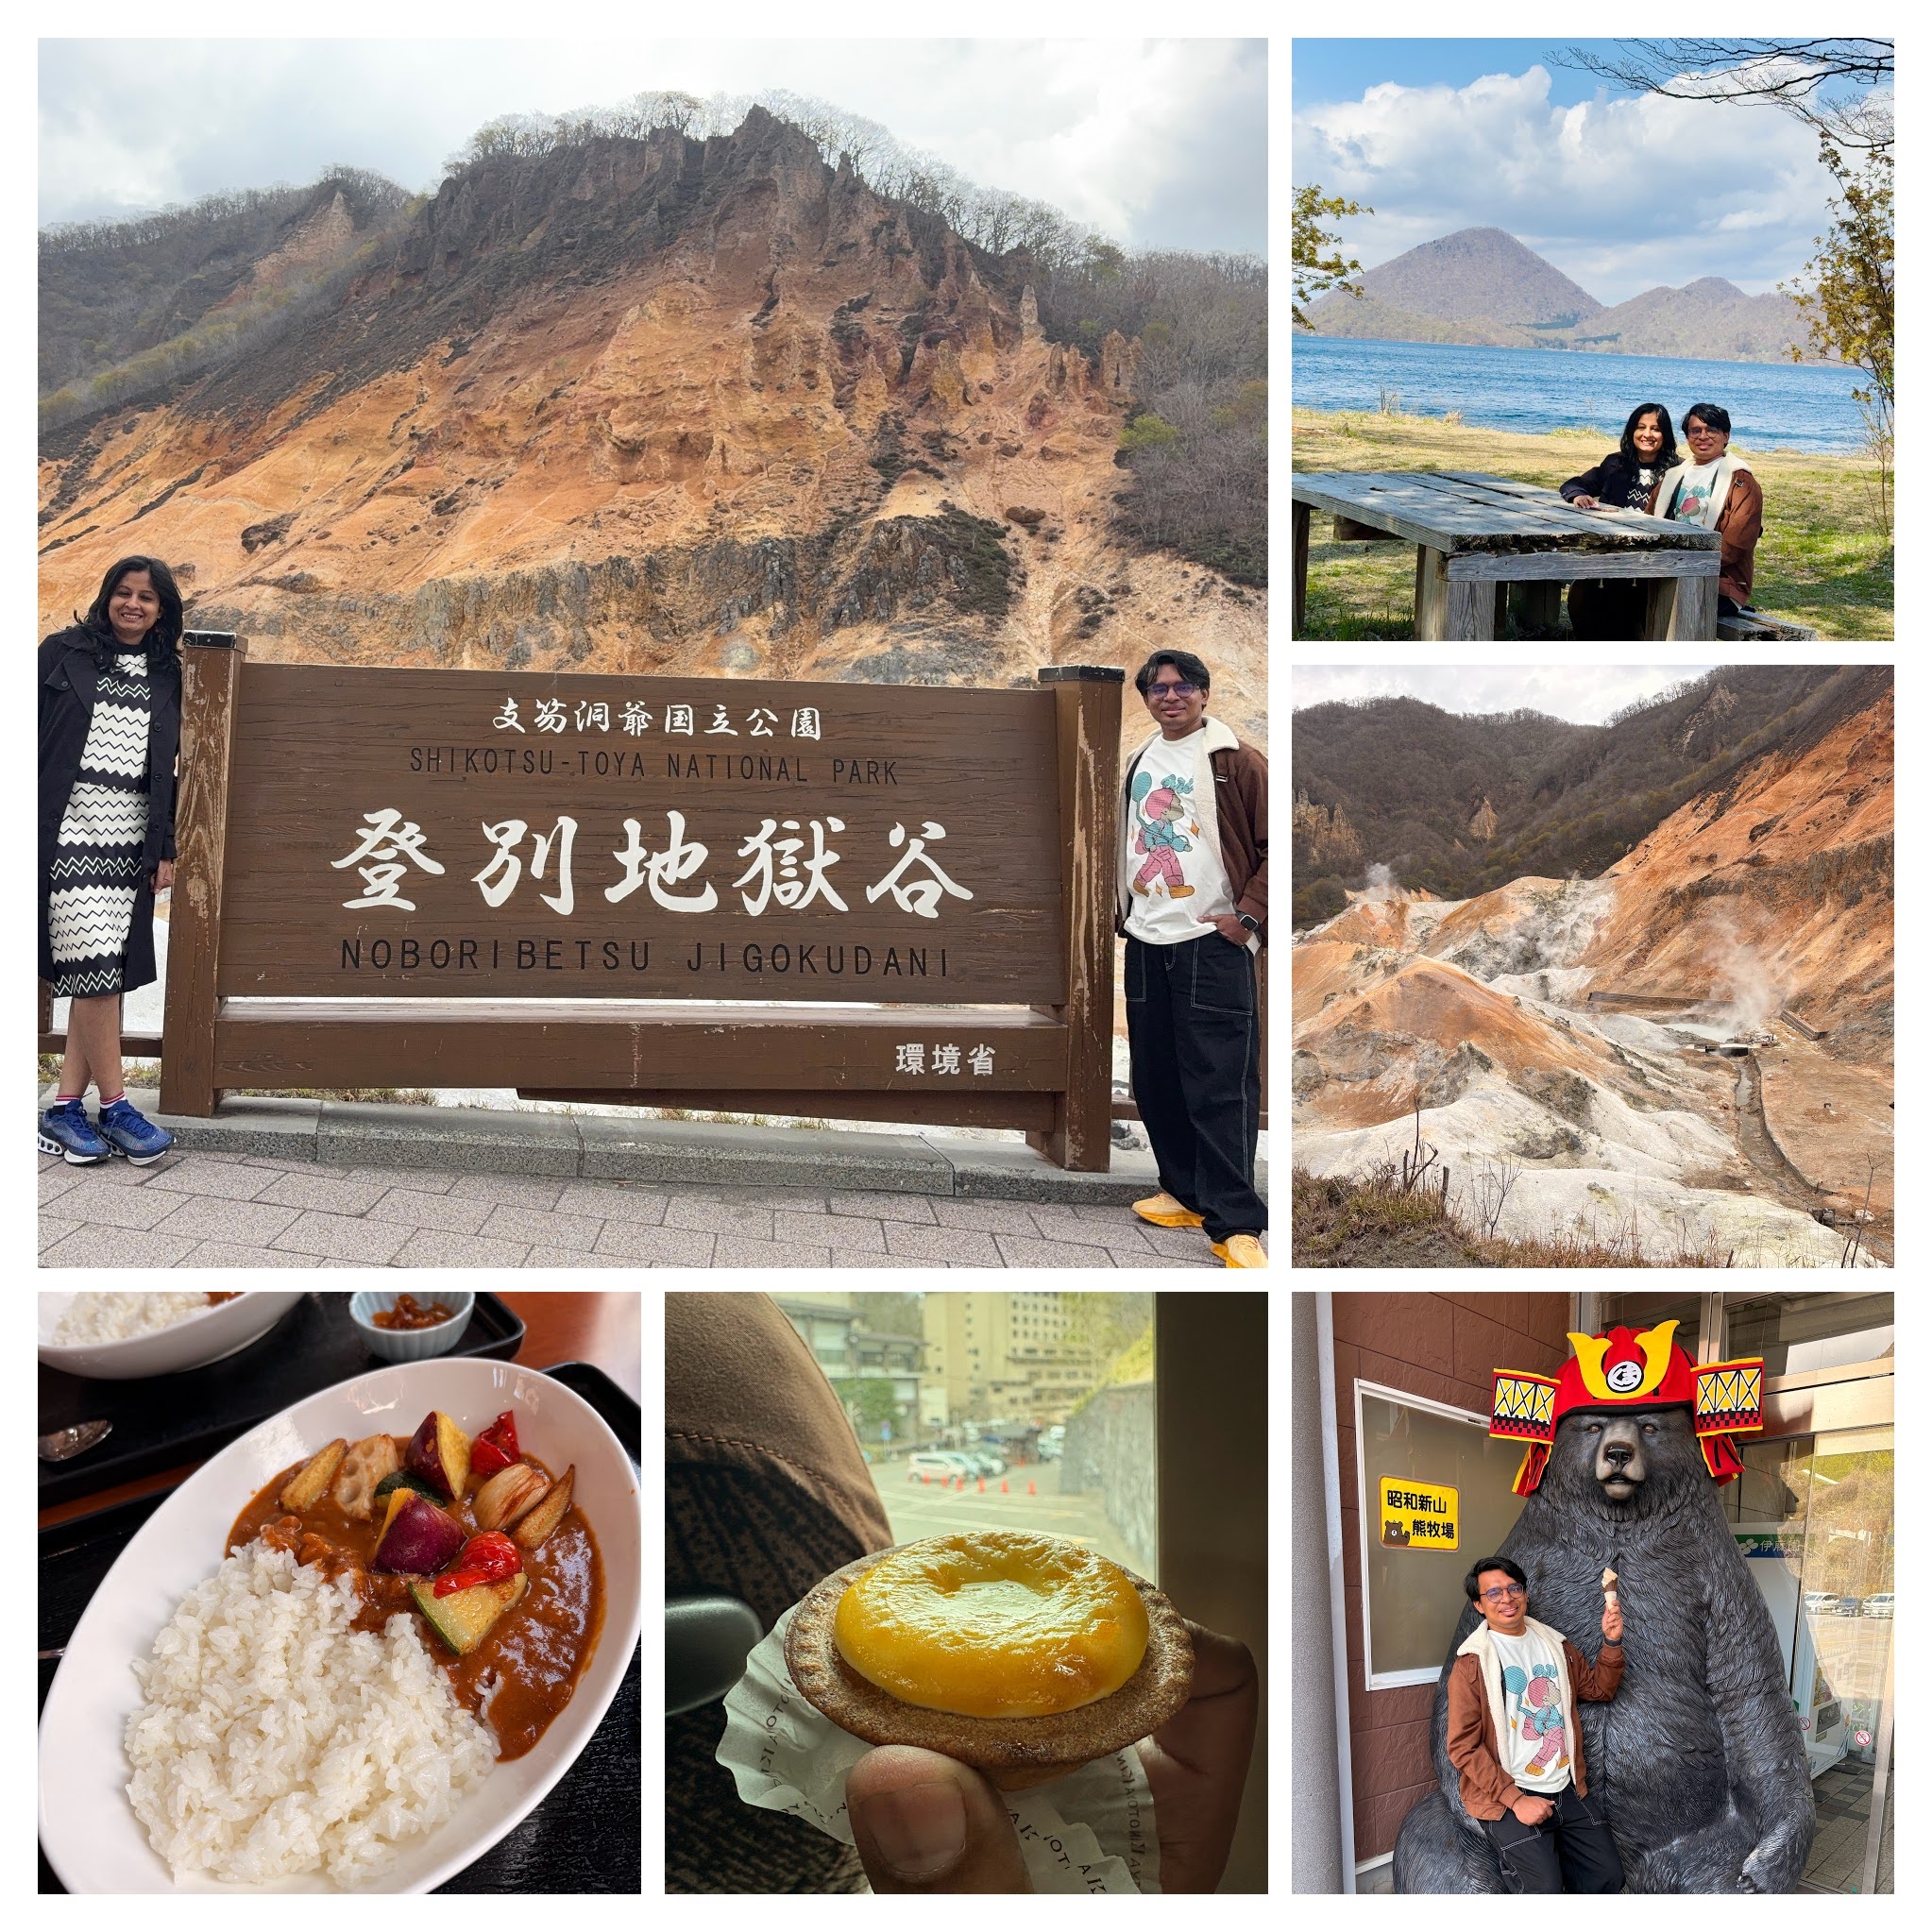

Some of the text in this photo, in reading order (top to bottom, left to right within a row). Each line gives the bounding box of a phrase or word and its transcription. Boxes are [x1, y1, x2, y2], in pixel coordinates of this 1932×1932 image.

[492, 697, 822, 741] 支笏洞爺国立公園
[410, 747, 898, 786] SHIKOTSU-TOYA NATIONAL PARK
[330, 807, 974, 919] 登別地獄谷
[341, 939, 947, 977] NOBORIBETSU JIGOKUDANI
[895, 1042, 996, 1076] 環境省
[1387, 1489, 1447, 1514] 昭和新山
[1412, 1518, 1455, 1540] 熊牧場
